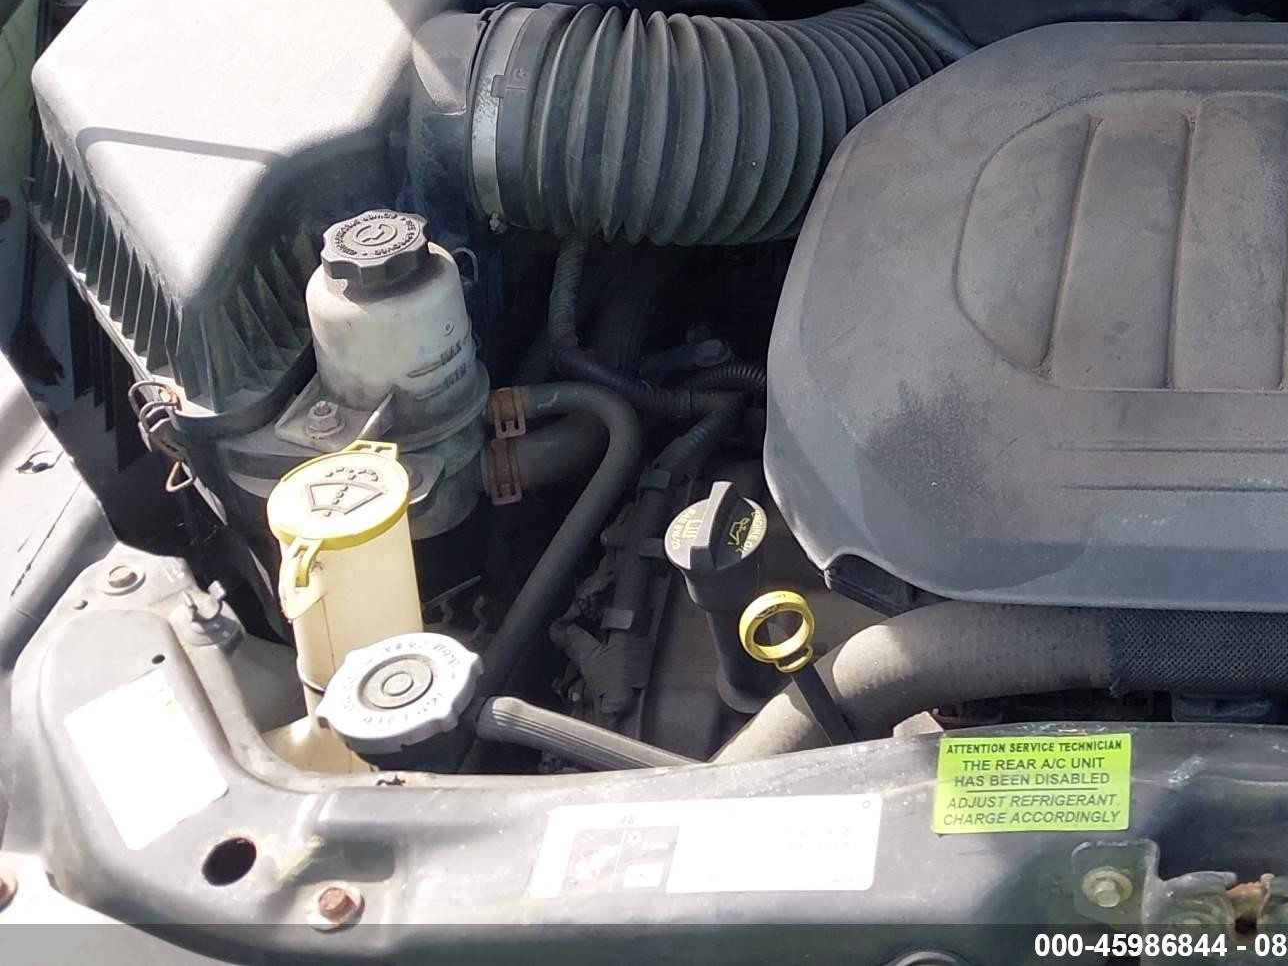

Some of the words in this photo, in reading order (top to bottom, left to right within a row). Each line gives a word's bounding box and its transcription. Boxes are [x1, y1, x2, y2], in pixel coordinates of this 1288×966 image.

[750, 509, 764, 541] ENGINE
[947, 742, 1005, 754] ATTENTION
[1009, 741, 1054, 753] SERVICE
[1059, 740, 1122, 752] TECHNICIAN
[962, 760, 991, 771] THE
[995, 758, 1036, 770] REAR
[1041, 757, 1066, 769] A/C
[1071, 757, 1105, 769] UNIT
[954, 775, 985, 788] HAS
[990, 774, 1030, 786] BEEN
[1035, 772, 1110, 785] DISABLED
[947, 795, 1006, 809] ADJUST
[1010, 794, 1117, 807] REFRIGERANT
[943, 812, 1005, 826] CHARGE
[1010, 810, 1121, 824] ACCORDINGLY
